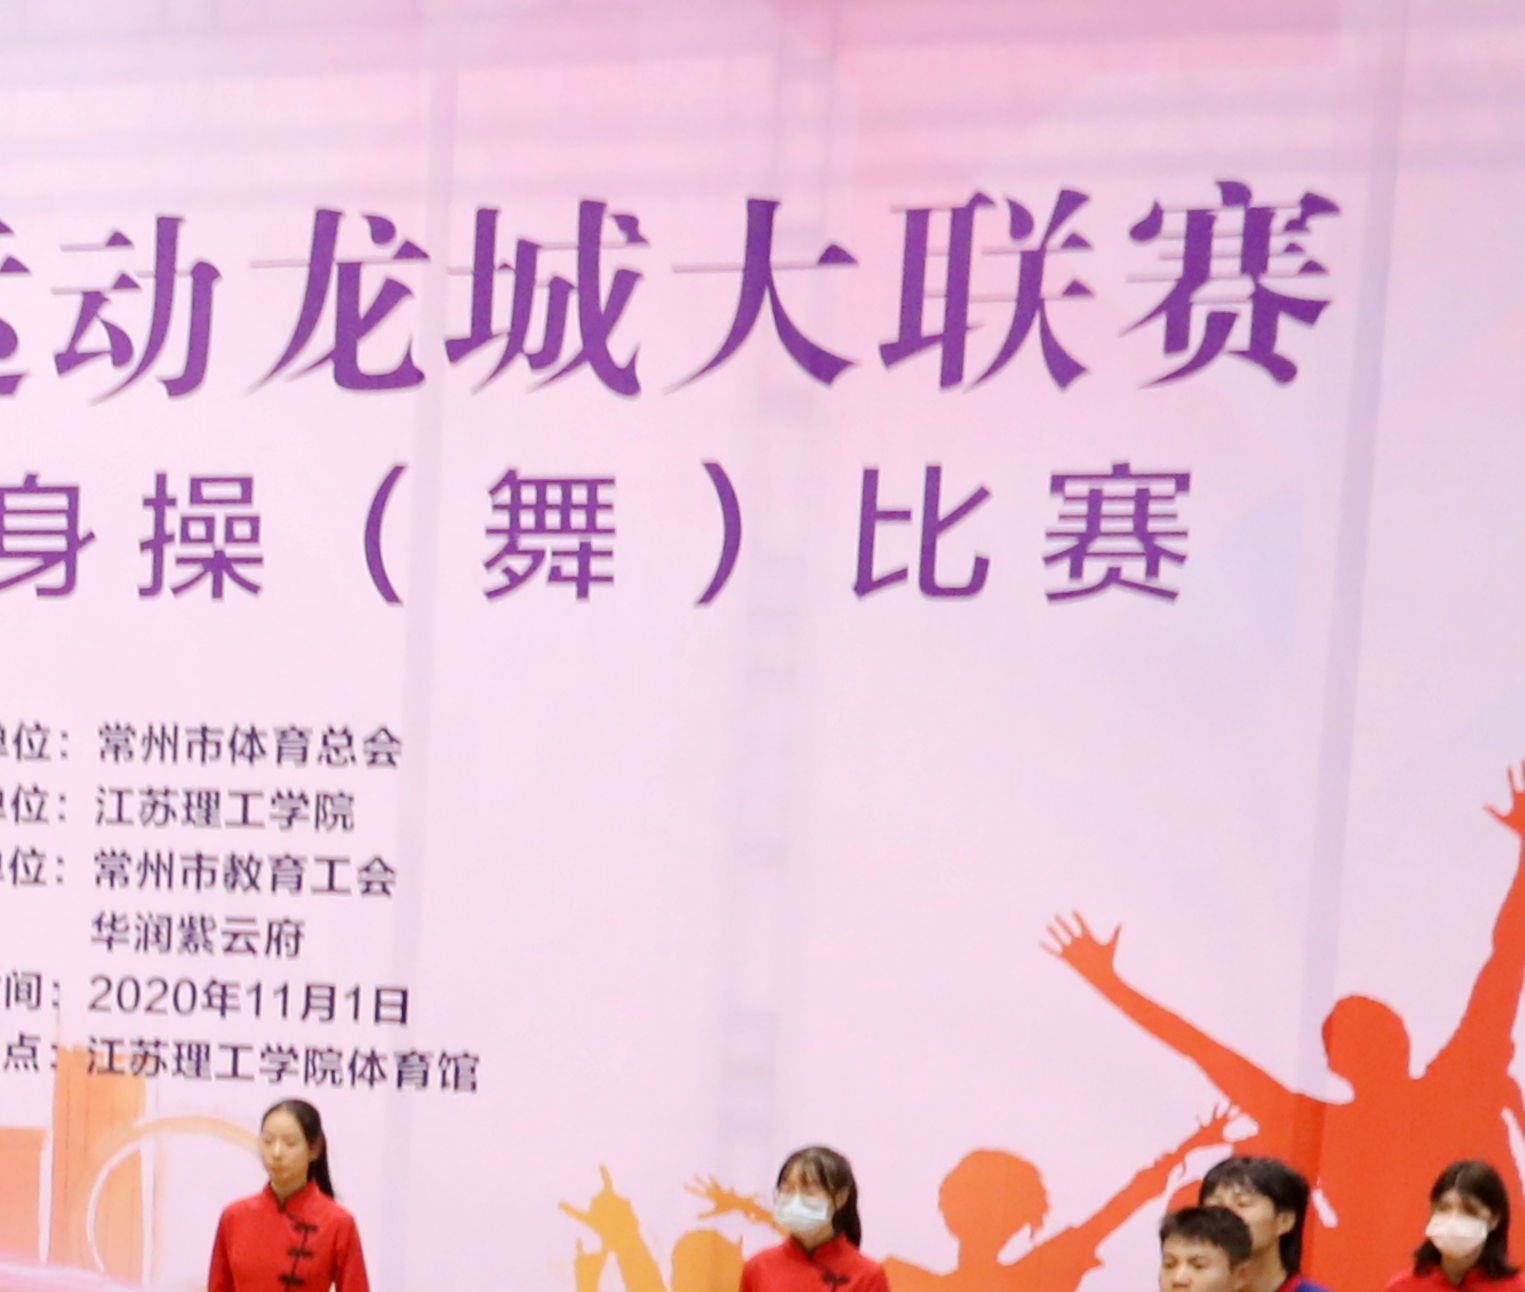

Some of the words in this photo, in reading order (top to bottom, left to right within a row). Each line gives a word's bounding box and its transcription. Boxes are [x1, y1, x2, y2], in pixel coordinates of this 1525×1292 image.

[90, 910, 306, 959] 华润紫云府
